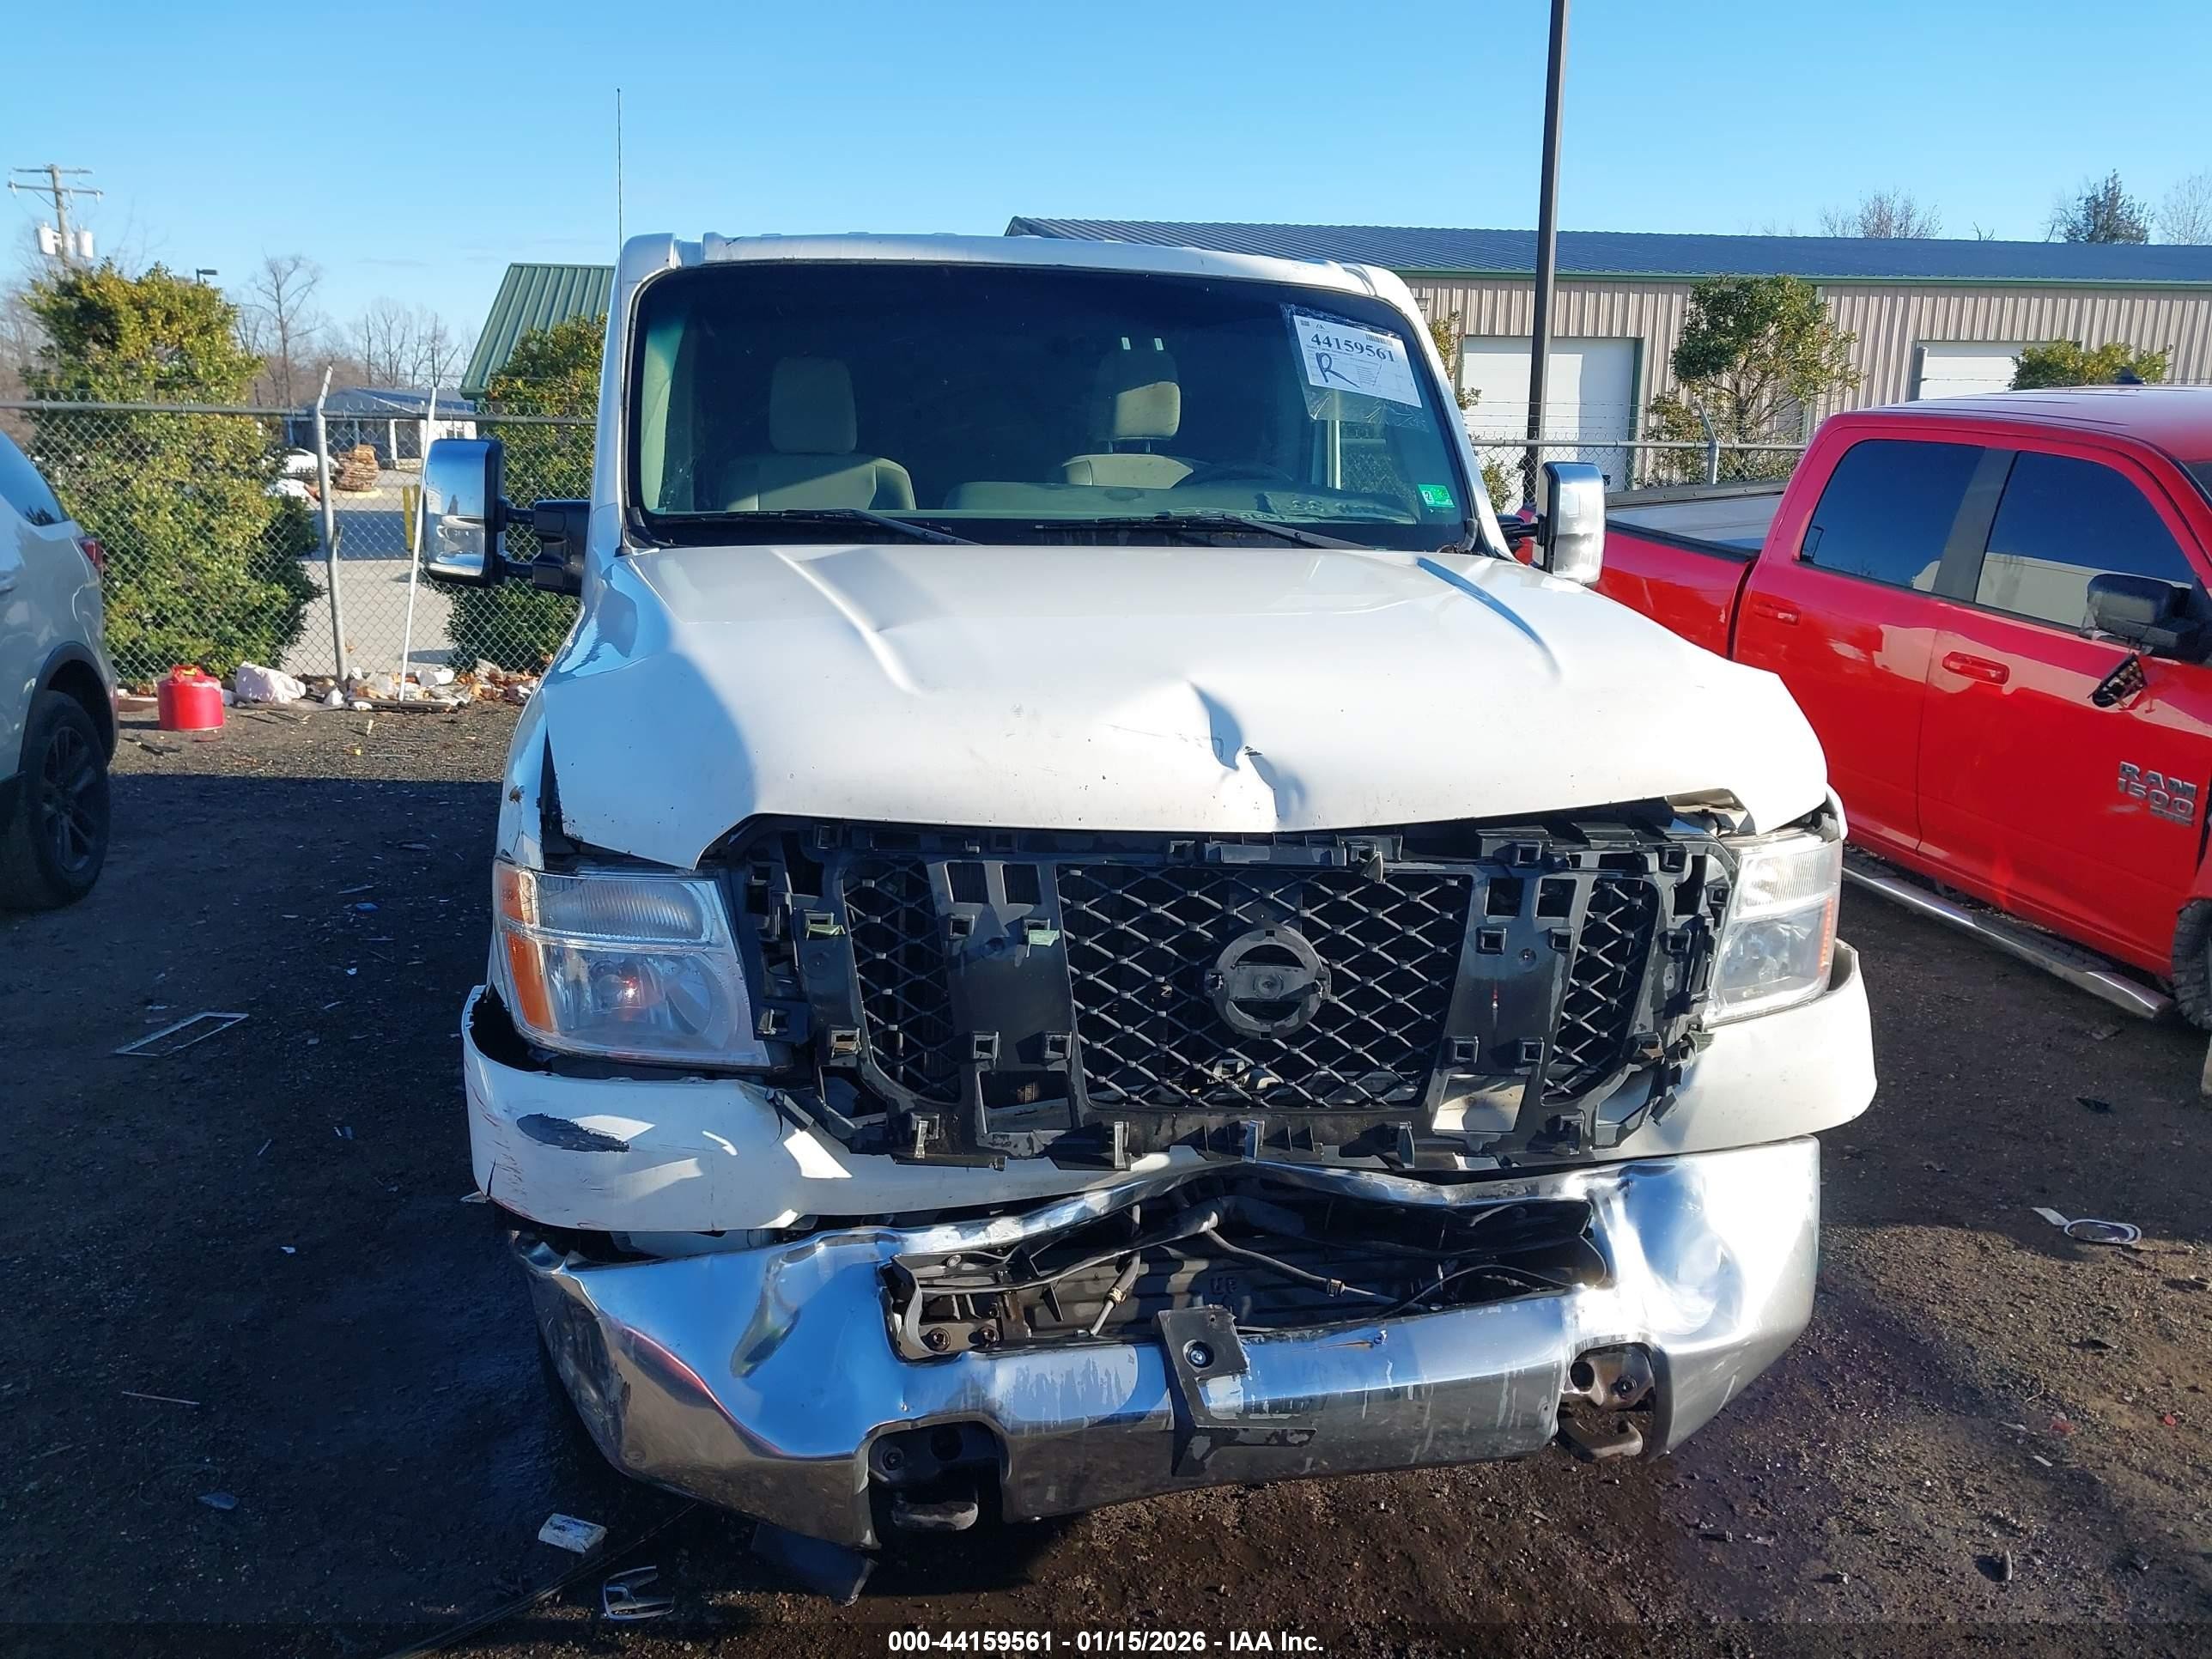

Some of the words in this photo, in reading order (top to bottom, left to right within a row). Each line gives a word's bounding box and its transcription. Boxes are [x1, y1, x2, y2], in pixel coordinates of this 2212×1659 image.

[1310, 333, 1395, 362] 44159561
[1316, 352, 1361, 389] R
[2118, 761, 2197, 800] RAM
[2118, 777, 2195, 817] 1500
